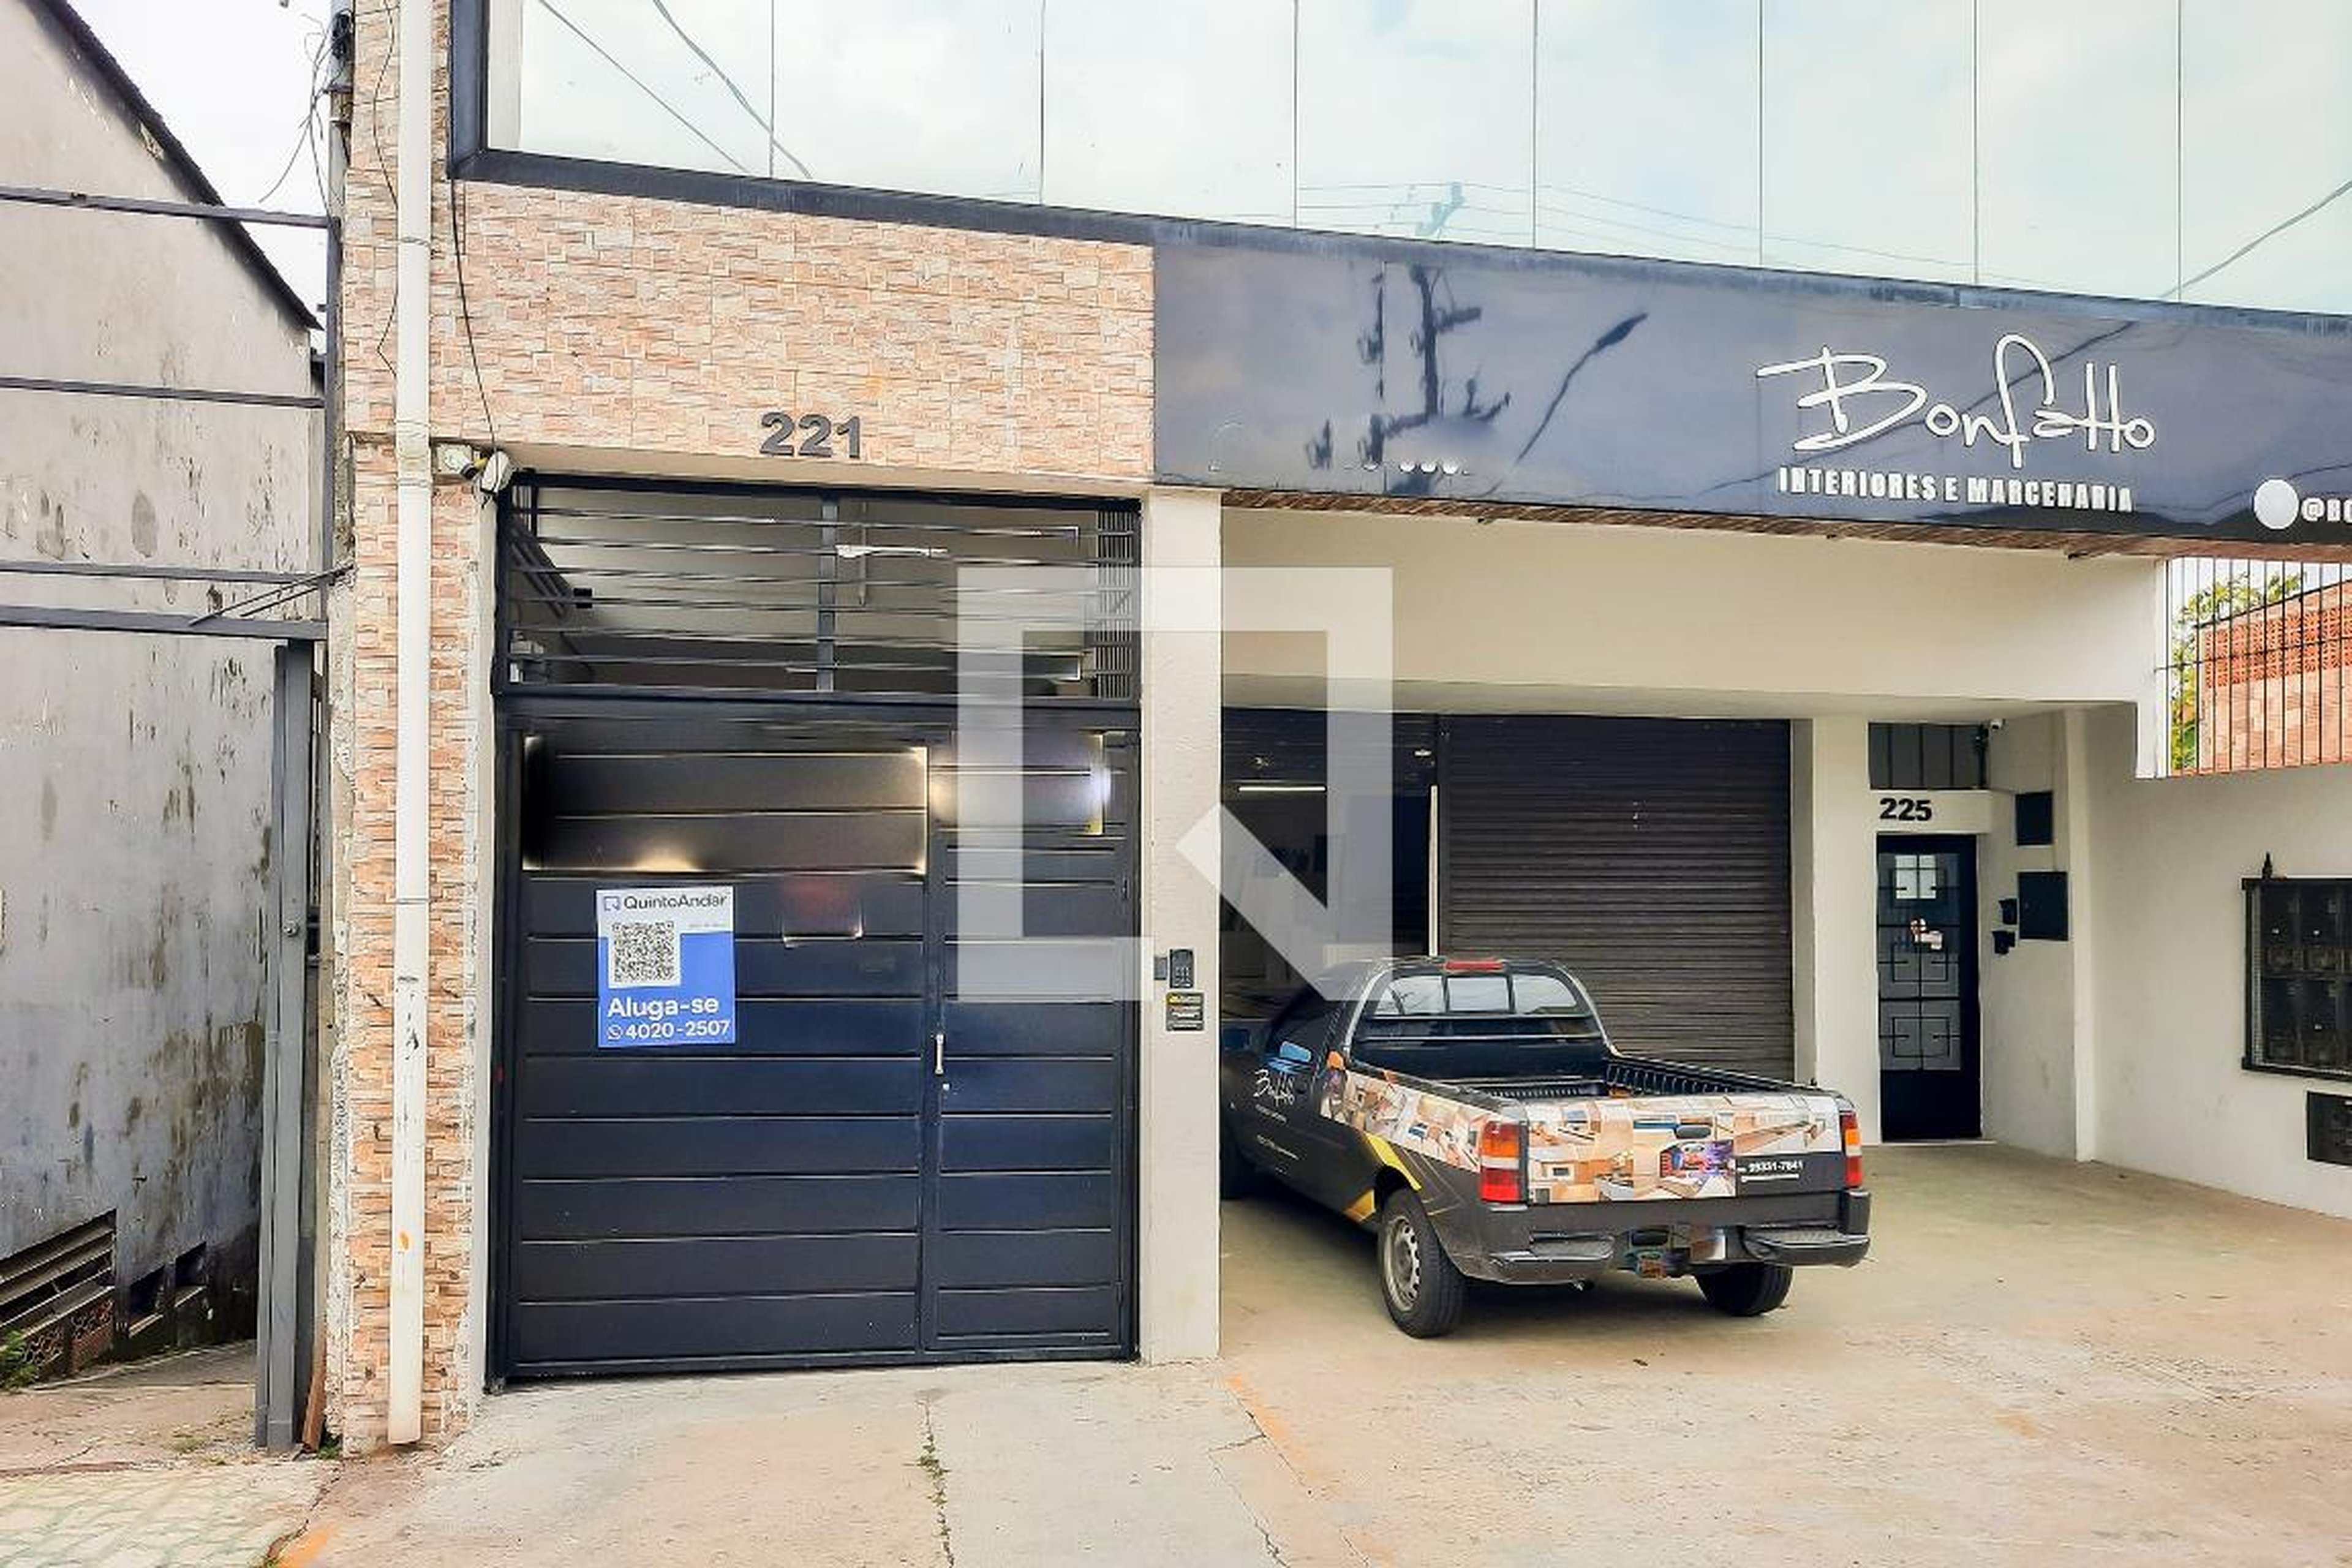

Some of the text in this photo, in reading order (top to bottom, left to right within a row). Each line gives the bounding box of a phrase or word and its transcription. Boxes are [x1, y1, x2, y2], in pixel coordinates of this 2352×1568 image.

[1756, 333, 2155, 469] Bonfatto
[760, 412, 860, 458] 221
[1779, 466, 2132, 512] INTERIORES E MARCENARIA
[1880, 797, 1932, 821] 225
[624, 894, 727, 910] QuintoAndar
[607, 997, 719, 1021] Aluga-se
[625, 1019, 730, 1039] 4020-2507
